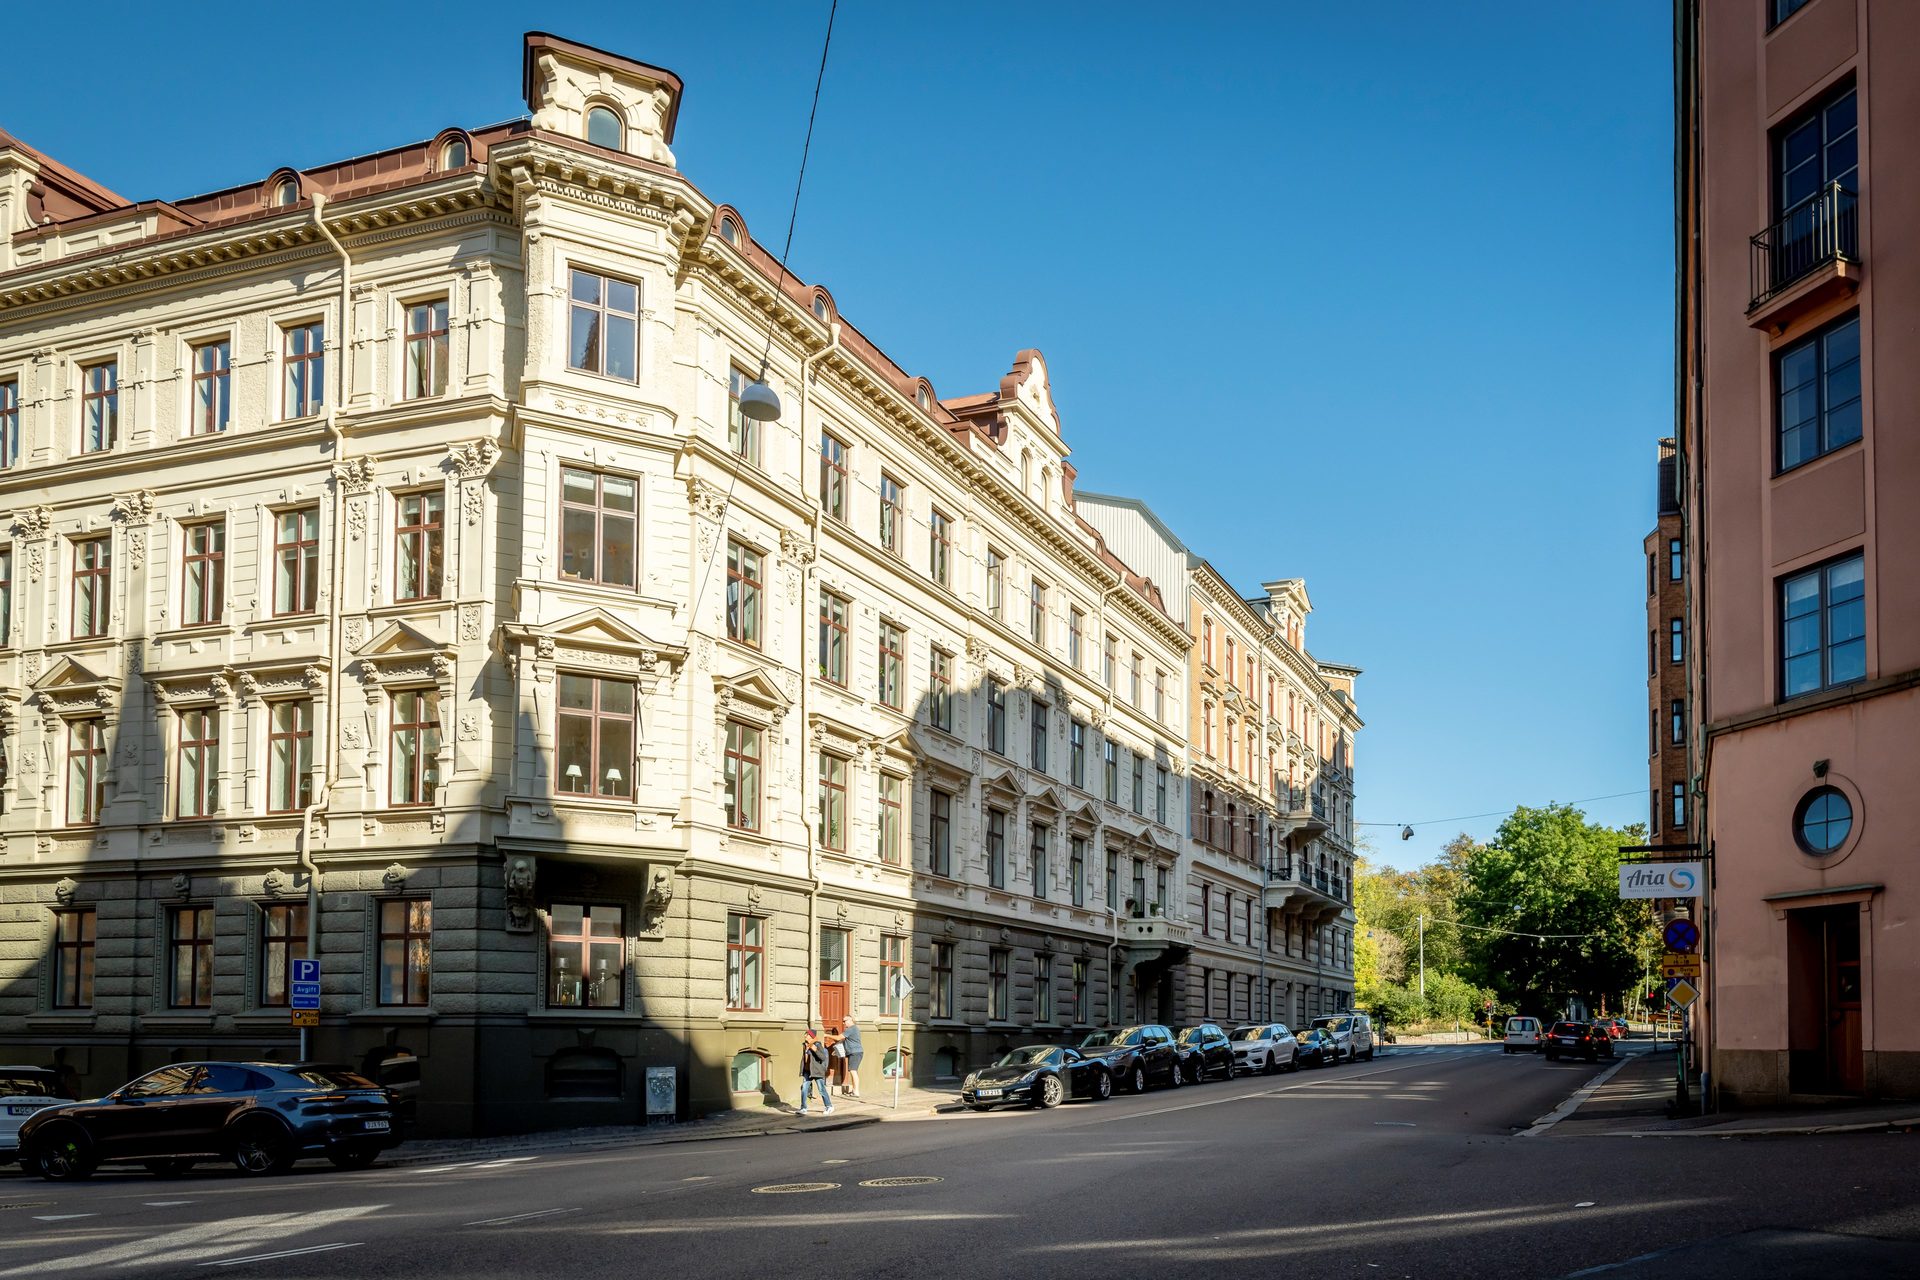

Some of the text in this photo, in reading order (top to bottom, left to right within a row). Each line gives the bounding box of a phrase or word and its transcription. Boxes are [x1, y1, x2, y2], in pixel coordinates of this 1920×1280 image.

[1626, 869, 1665, 889] Aria
[301, 961, 314, 980] P
[296, 986, 317, 994] Avgift
